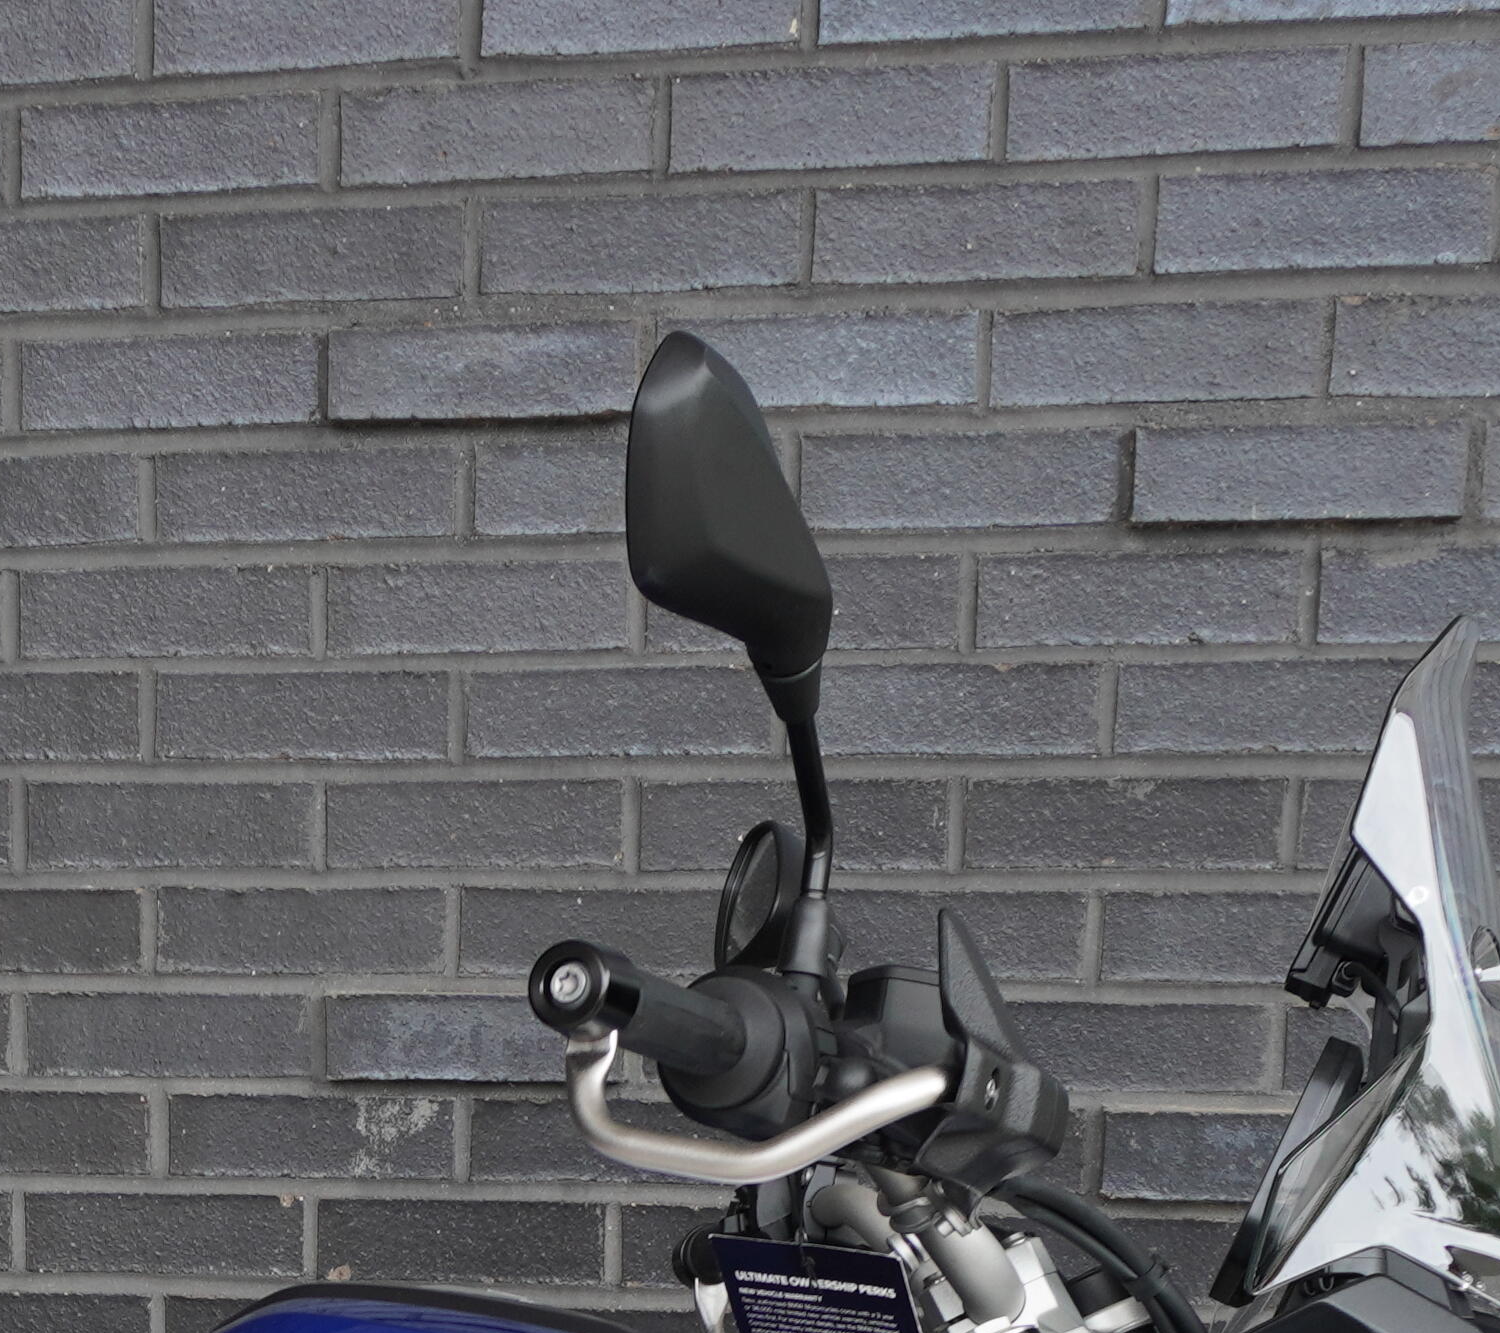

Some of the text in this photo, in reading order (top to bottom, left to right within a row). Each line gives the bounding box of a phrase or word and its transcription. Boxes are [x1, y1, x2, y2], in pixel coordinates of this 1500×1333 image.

[735, 1270, 896, 1299] ULTIMATE OWERSHIP PERKS
